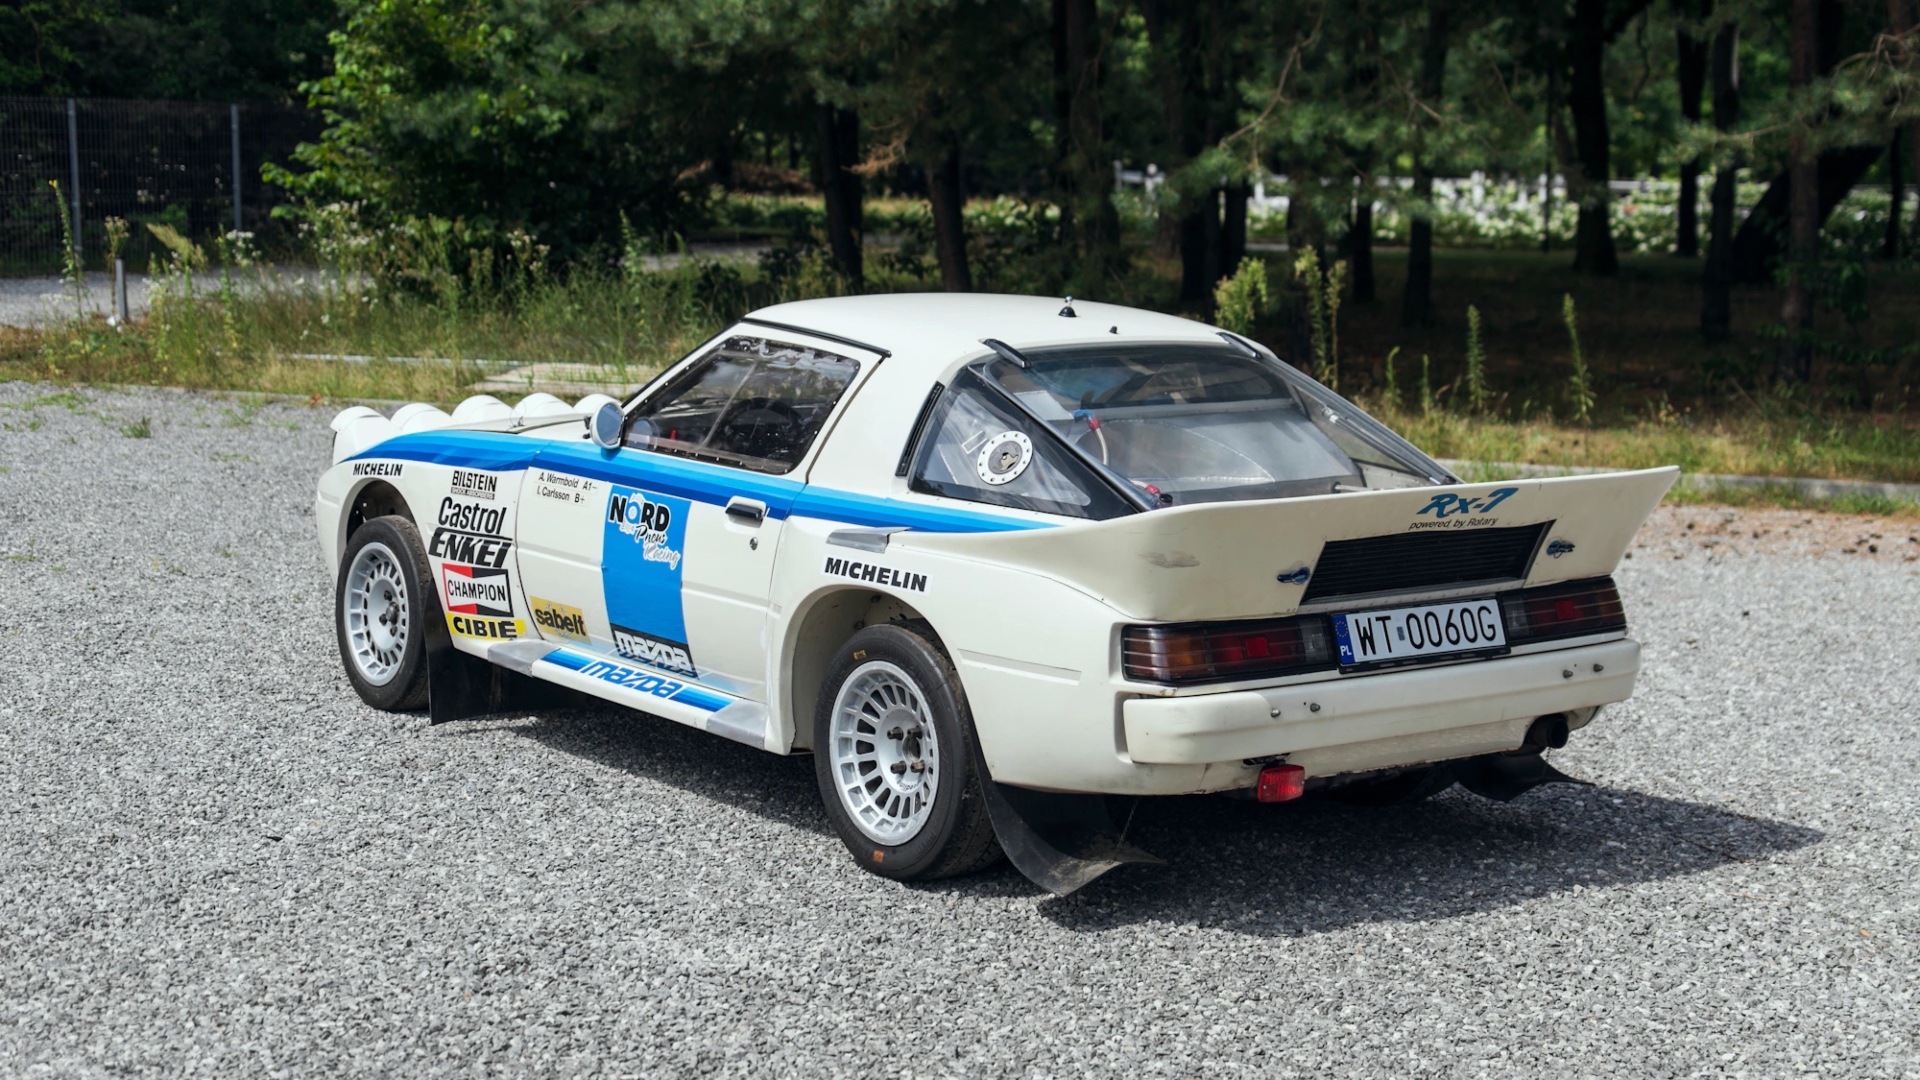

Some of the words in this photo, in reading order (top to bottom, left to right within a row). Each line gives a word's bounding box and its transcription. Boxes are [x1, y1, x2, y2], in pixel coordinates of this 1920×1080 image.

[352, 463, 403, 476] MICHELIN
[452, 470, 498, 492] BILSTEIN
[547, 473, 580, 489] Warmbold
[542, 486, 570, 501] Carlsson
[438, 496, 507, 535] Castrol
[609, 494, 670, 532] NORD
[1408, 520, 1452, 530] powered
[1453, 519, 1465, 528] by
[1467, 517, 1499, 527] Rotary
[428, 527, 513, 568] ENKEI
[644, 542, 679, 569] Racing
[824, 557, 927, 592] MICHELIN
[447, 580, 506, 601] CHAMPION
[535, 608, 587, 636] sabelt
[1355, 615, 1392, 656] WT
[1405, 605, 1497, 649] 0060G
[1340, 645, 1352, 656] PL
